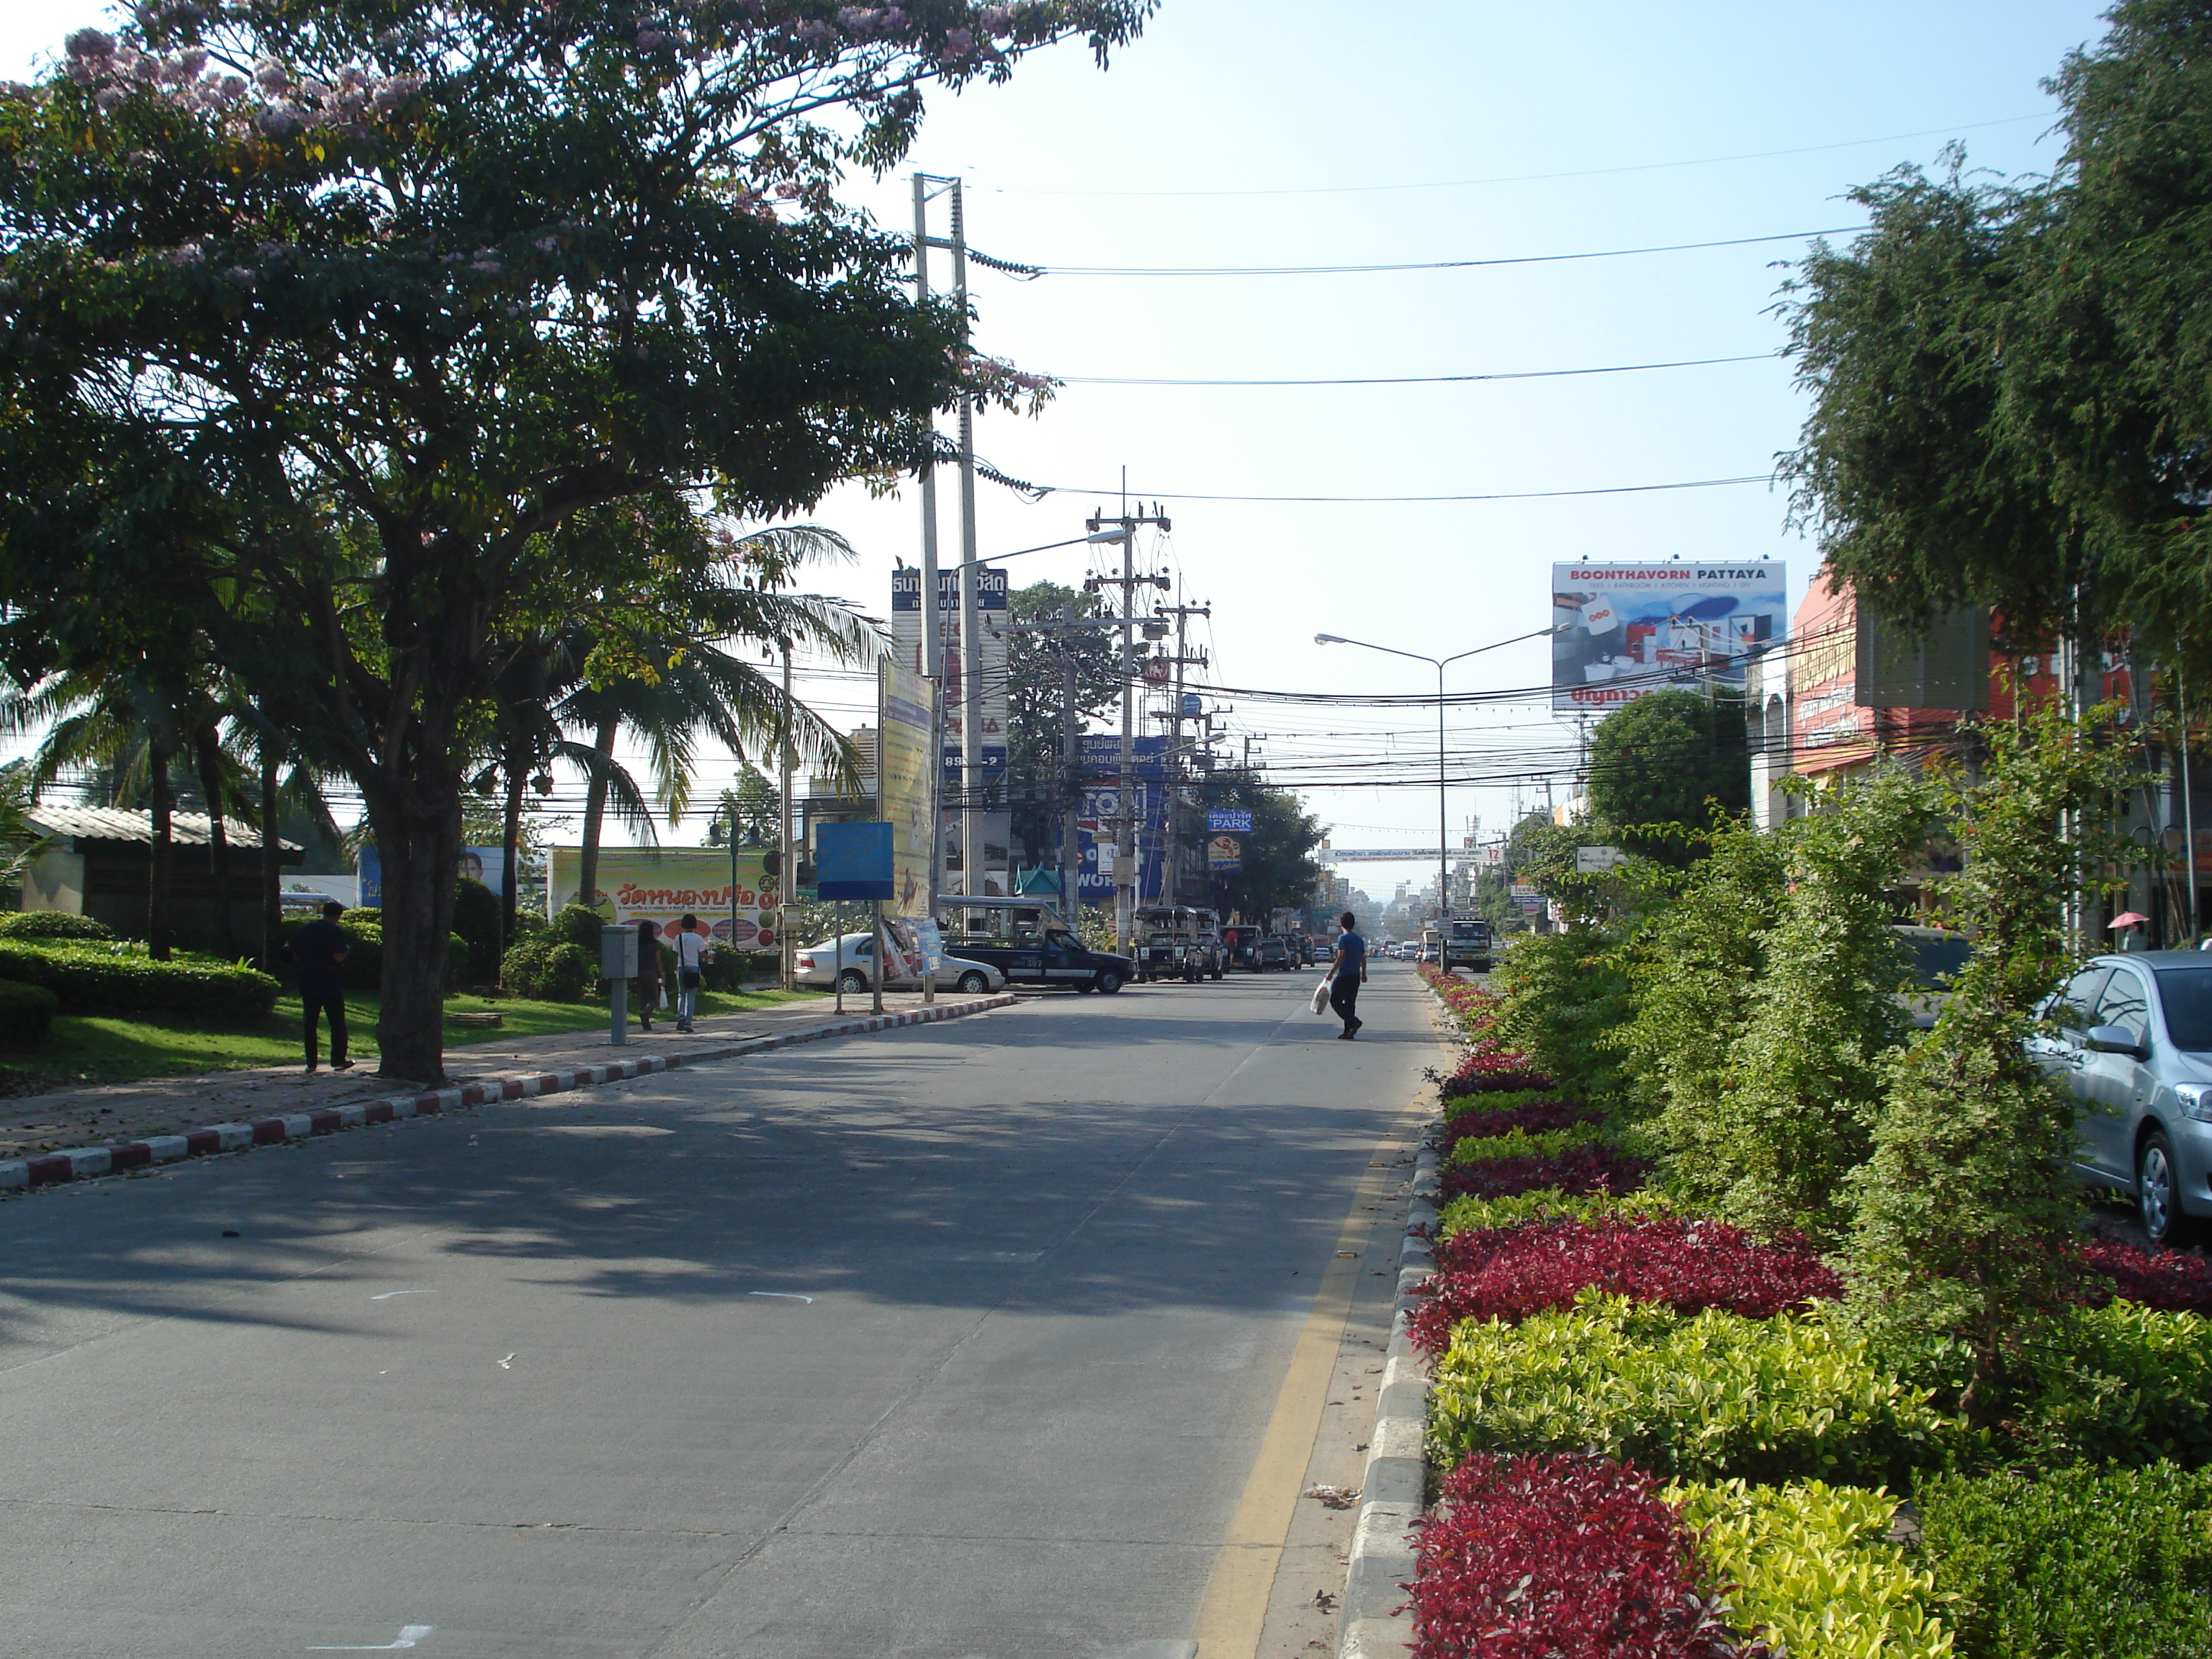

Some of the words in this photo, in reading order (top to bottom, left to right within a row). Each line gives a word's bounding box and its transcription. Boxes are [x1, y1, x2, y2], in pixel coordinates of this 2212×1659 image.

[1570, 570, 1691, 580] BOONTHAVORN
[1697, 570, 1766, 579] PATTAYA
[1213, 819, 1251, 828] PARK
[1488, 850, 1500, 859] 12
